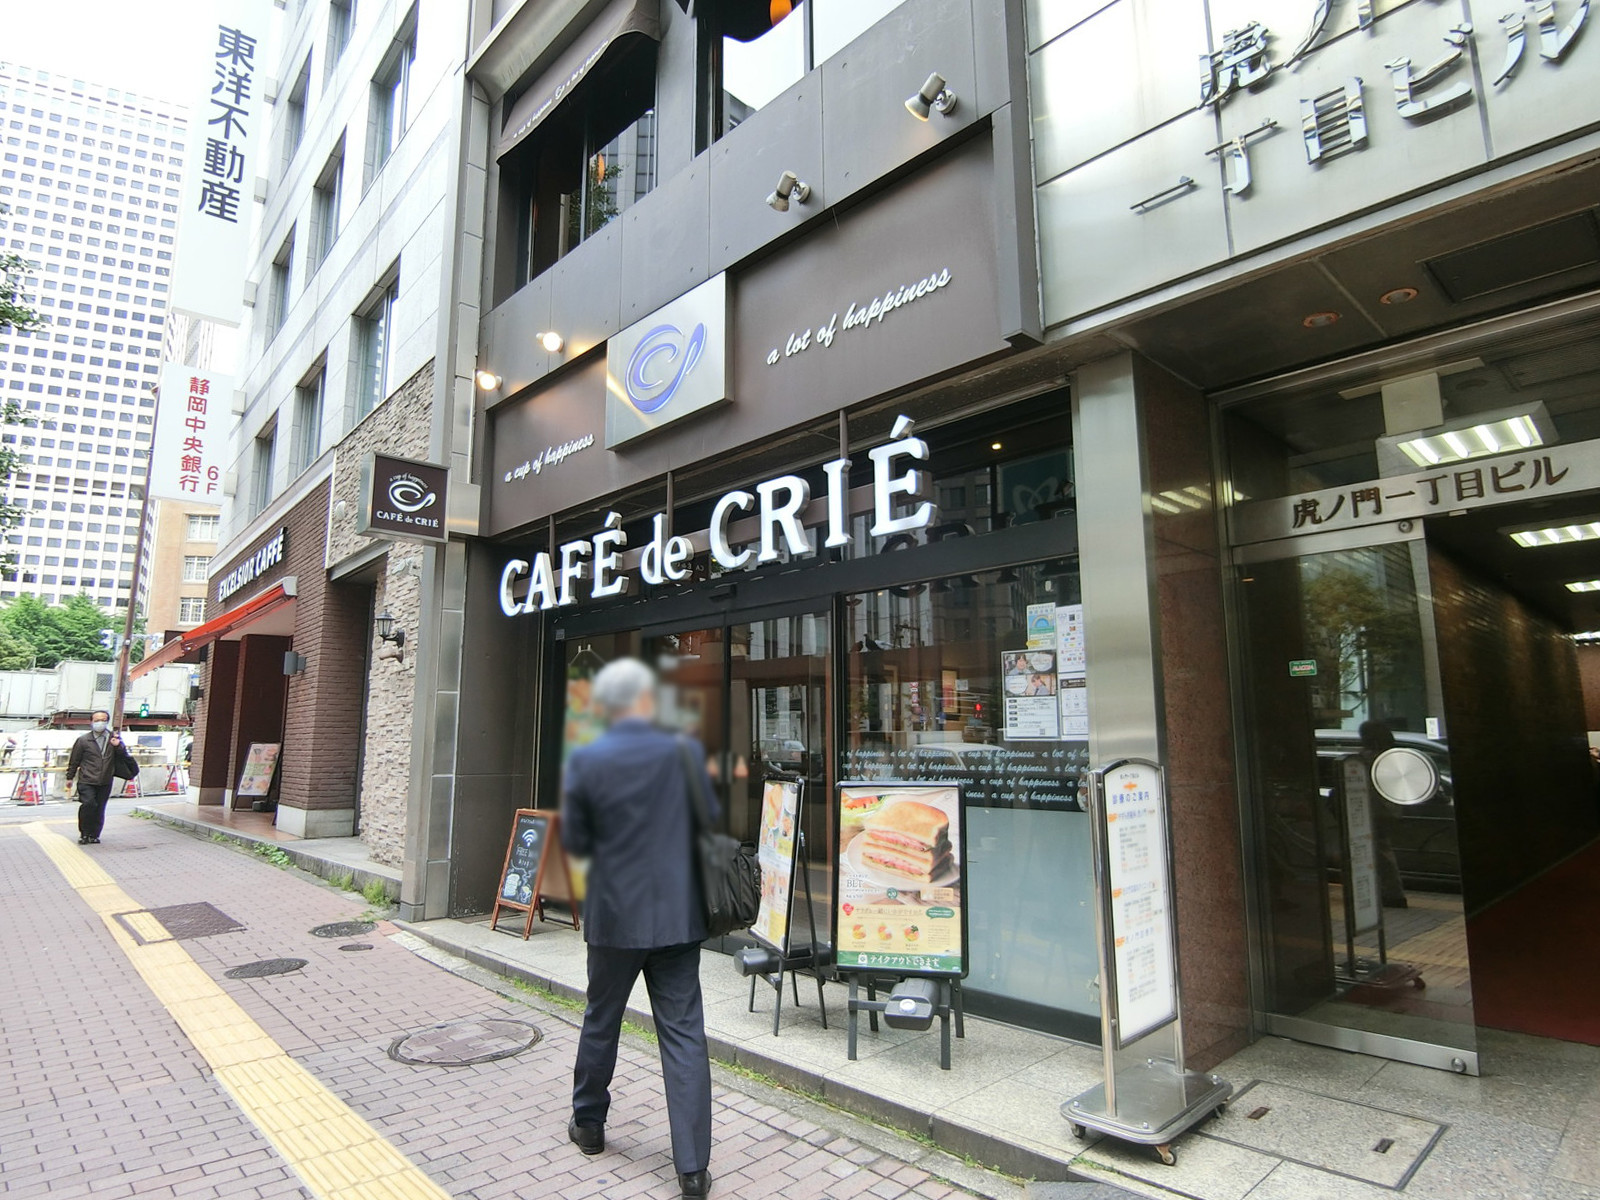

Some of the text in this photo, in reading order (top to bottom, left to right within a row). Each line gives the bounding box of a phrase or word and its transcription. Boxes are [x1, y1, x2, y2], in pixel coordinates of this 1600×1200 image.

[198, 24, 258, 224] 東洋不動産
[1130, 0, 1591, 212] 一丁目ビル
[766, 267, 952, 365] a lot of happiness
[179, 376, 210, 493] 静岡中央銀行
[504, 434, 594, 483] a cup of happiness
[207, 465, 219, 495] 6F
[1292, 456, 1569, 529] 虎ノ門一丁目ビル
[376, 511, 439, 528] CAFÉ de CRIÉ
[499, 414, 939, 617] CAFÉ de CRIÉ
[218, 526, 289, 602] EXCELSIOR CAFFÉ
[978, 764, 992, 774] cup
[995, 763, 1005, 774] of
[1007, 762, 1047, 773] happiness
[1065, 763, 1076, 772] lot
[995, 749, 1035, 759] happiness
[1052, 749, 1064, 758] lot
[1067, 749, 1077, 760] of
[989, 777, 1003, 787] cup
[1006, 777, 1015, 788] of
[1018, 776, 1059, 787] happiness
[1000, 791, 1015, 801] cup
[1018, 791, 1027, 802] of
[1030, 791, 1073, 801] happiness
[846, 880, 863, 888] BLT
[870, 955, 939, 968] テイクアウトできます
